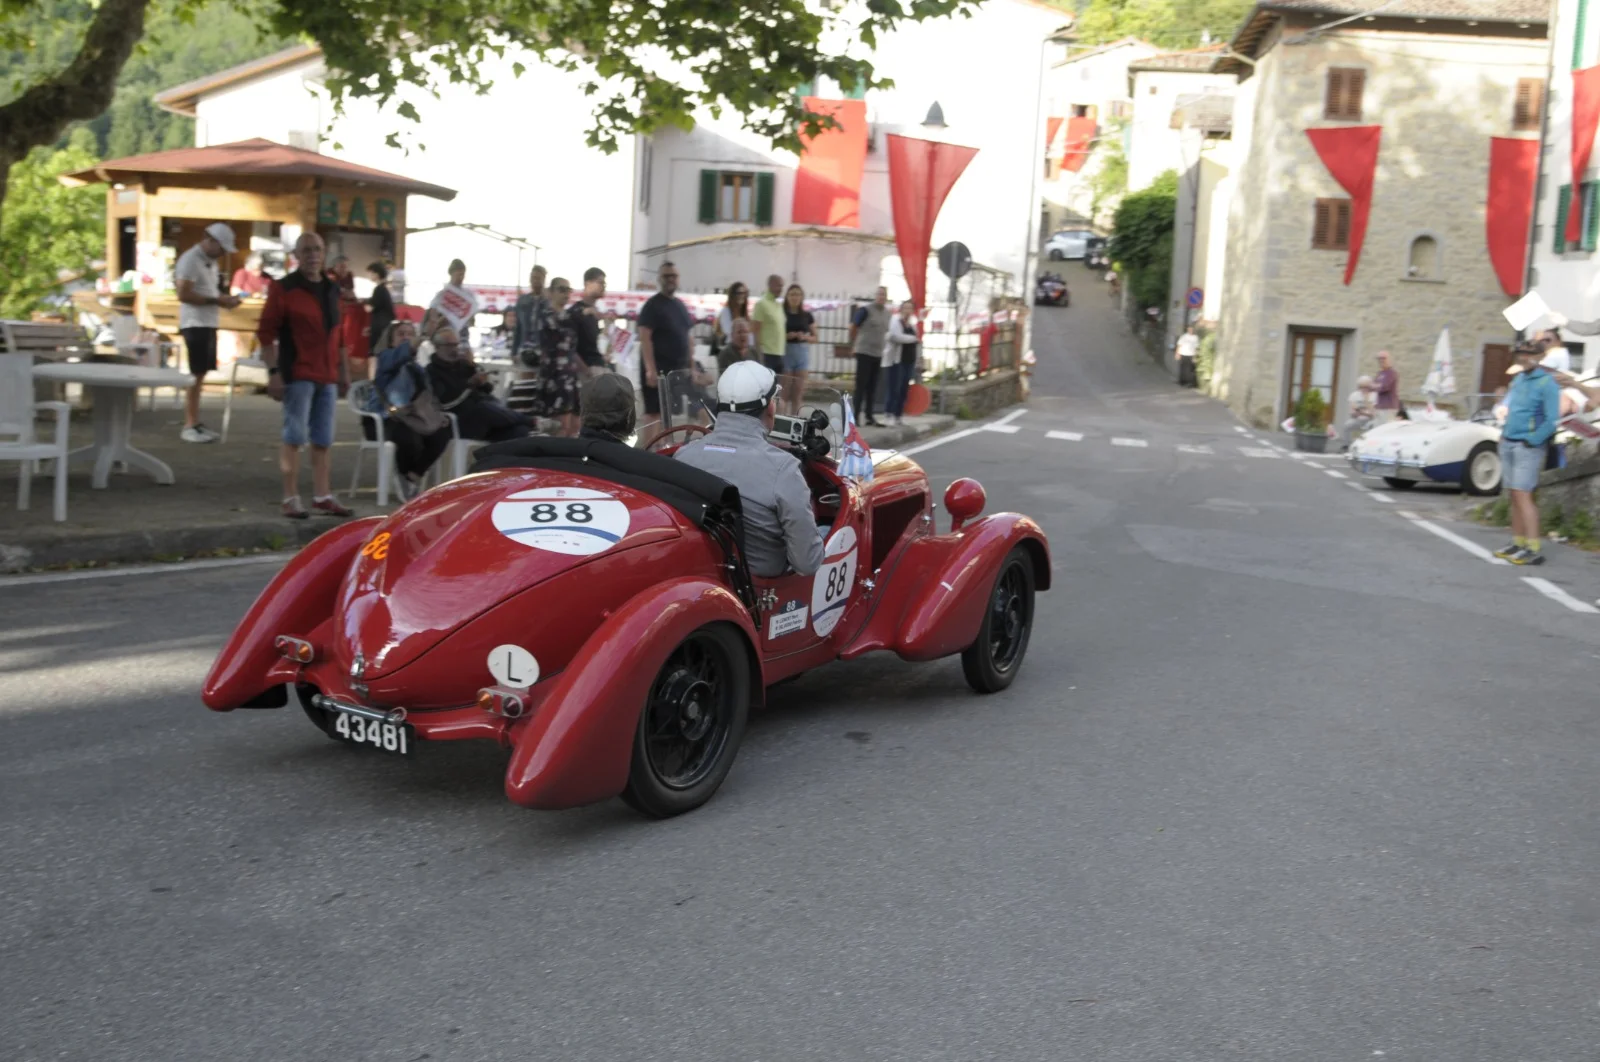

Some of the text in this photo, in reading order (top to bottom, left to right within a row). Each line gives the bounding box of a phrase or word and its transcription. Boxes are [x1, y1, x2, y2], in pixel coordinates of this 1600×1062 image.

[318, 193, 397, 230] BAR
[530, 503, 593, 523] 88
[825, 561, 847, 602] 88
[786, 600, 796, 611] 88
[507, 651, 522, 683] L
[336, 712, 407, 754] 43481
